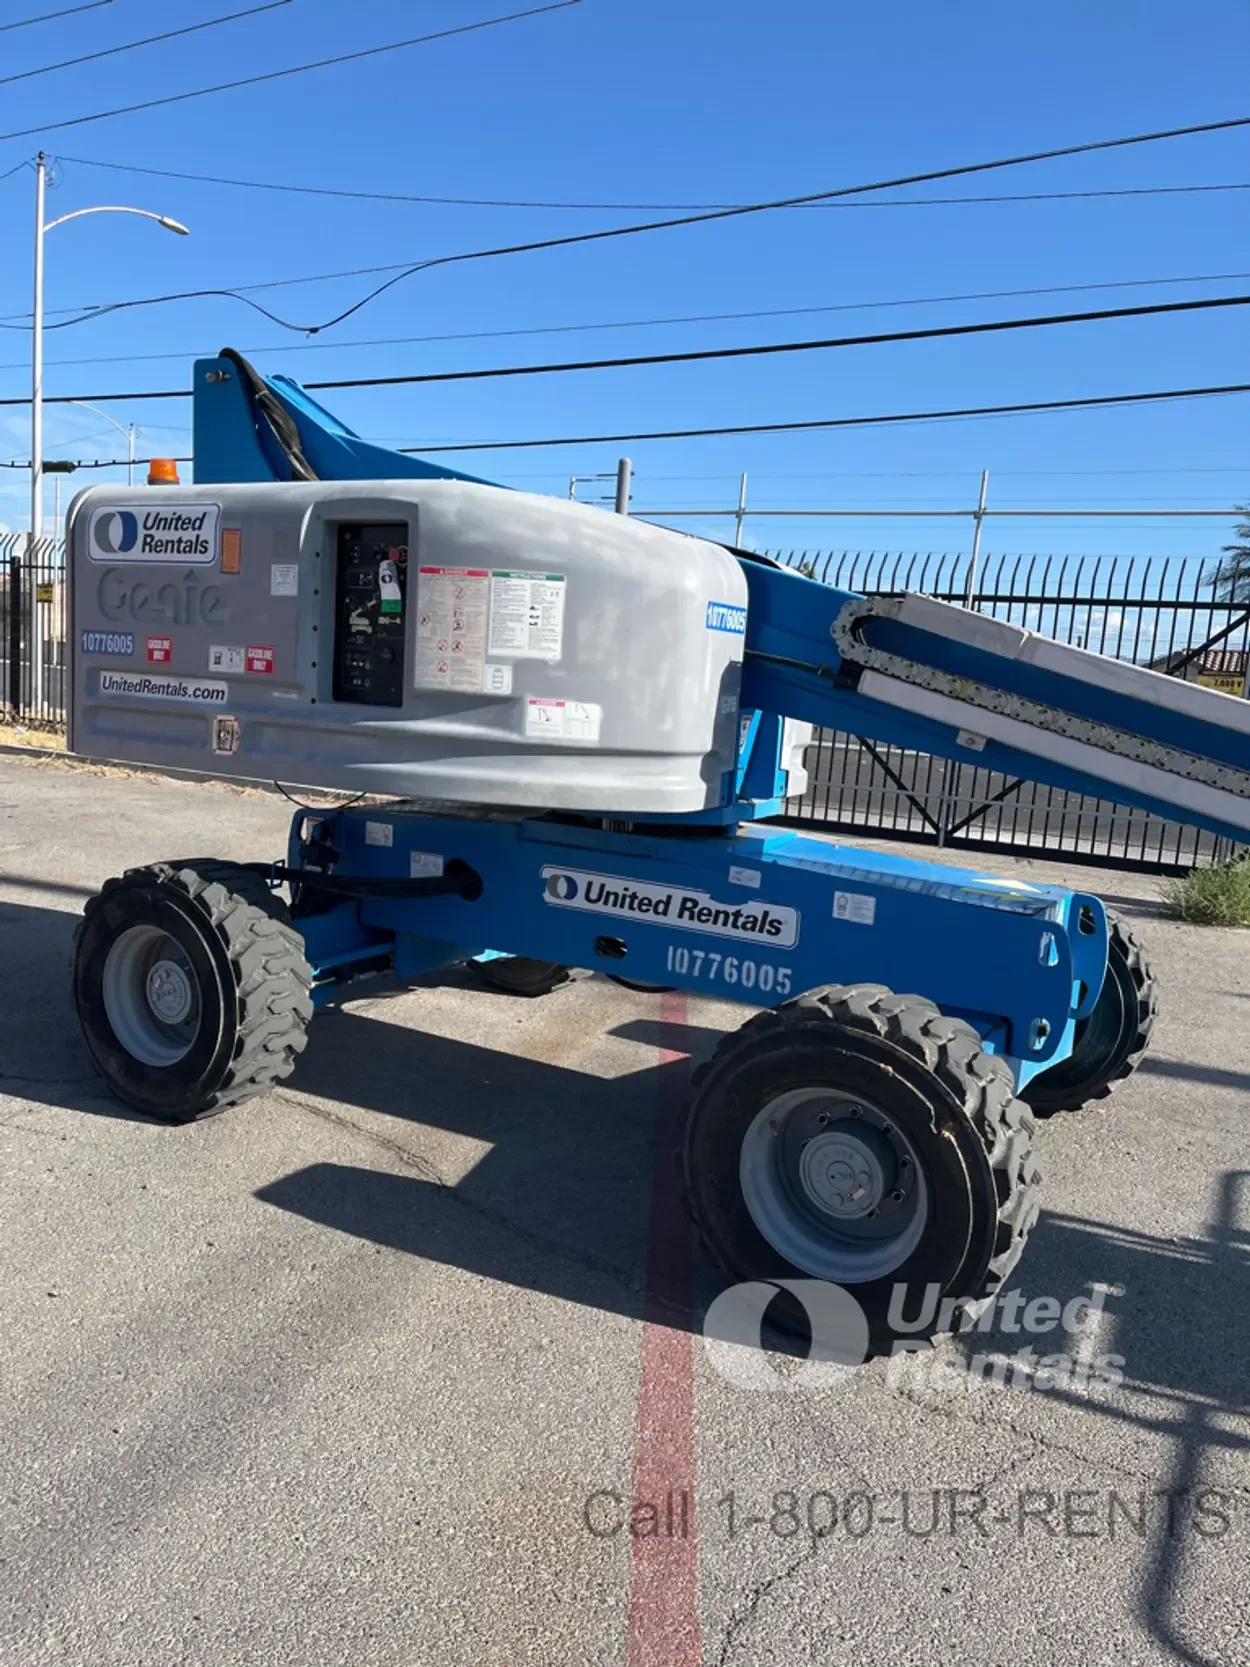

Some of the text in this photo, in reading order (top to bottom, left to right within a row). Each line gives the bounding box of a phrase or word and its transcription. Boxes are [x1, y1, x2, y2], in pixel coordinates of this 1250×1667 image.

[142, 512, 207, 531] United
[141, 534, 209, 554] Rentals
[97, 567, 226, 625] Genie
[82, 632, 133, 653] 10776005
[102, 675, 226, 701] UnitedRentals.com
[584, 880, 783, 937] United Rentals
[667, 945, 793, 995] 10776005
